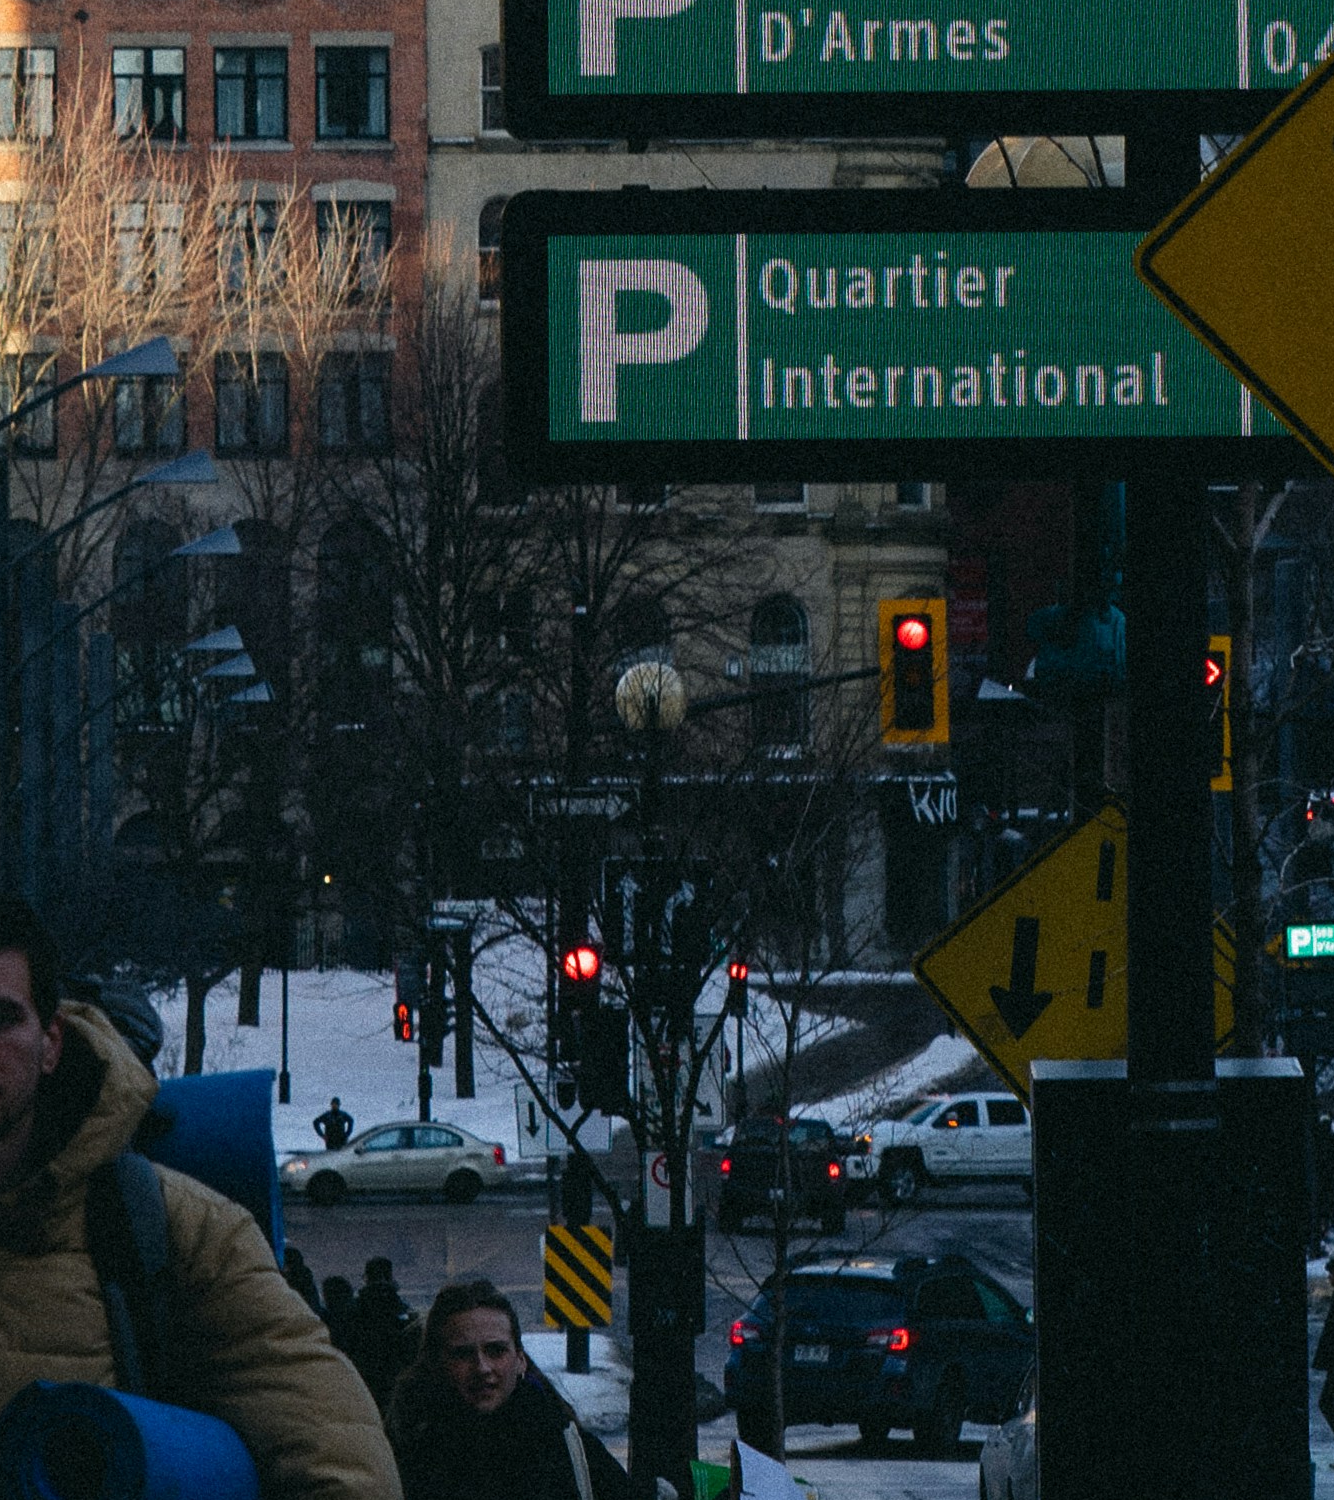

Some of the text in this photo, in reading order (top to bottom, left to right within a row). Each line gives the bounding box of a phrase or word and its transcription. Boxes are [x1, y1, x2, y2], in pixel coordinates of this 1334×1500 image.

[760, 9, 1012, 64] D'Armes
[760, 252, 1014, 315] Quartier
[578, 258, 710, 422] P
[761, 351, 1170, 410] International
